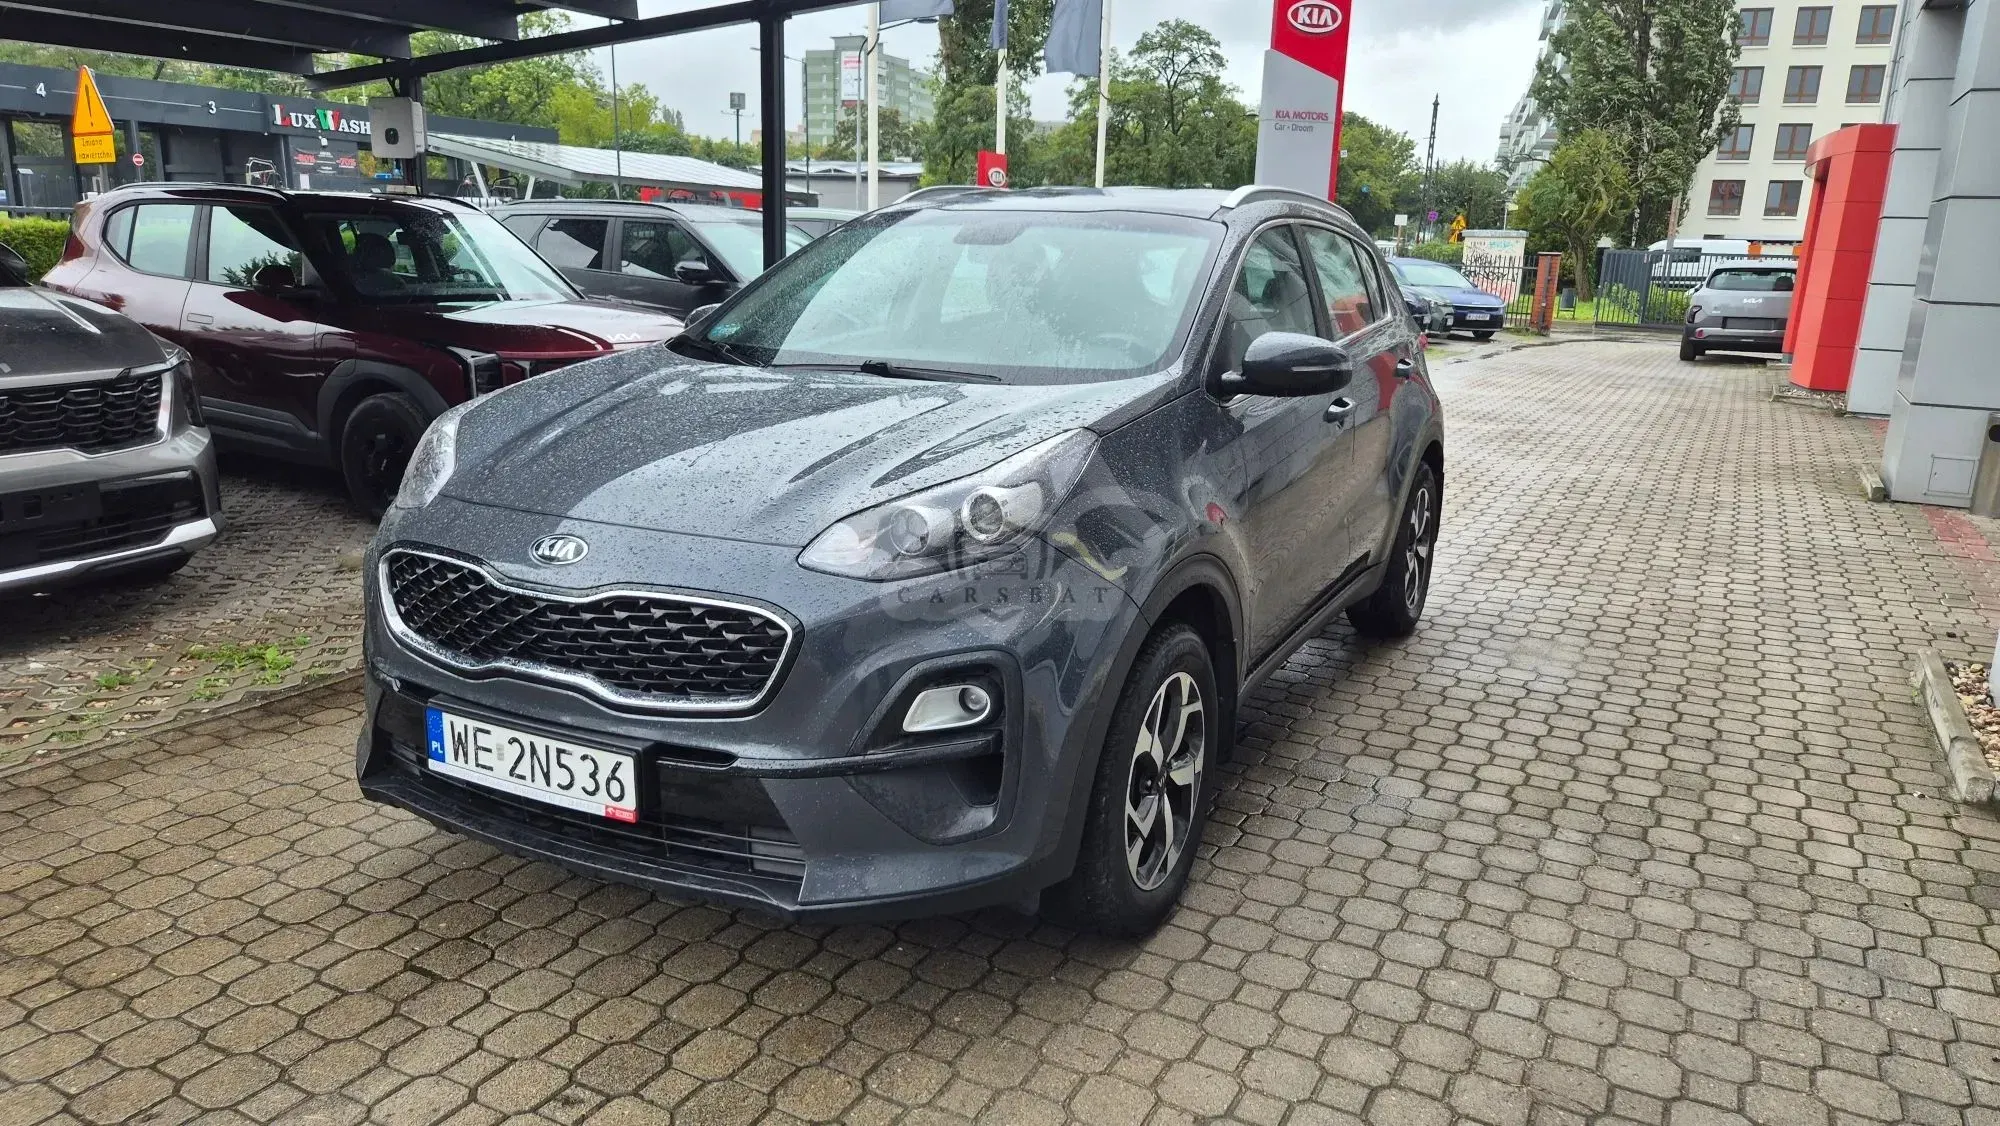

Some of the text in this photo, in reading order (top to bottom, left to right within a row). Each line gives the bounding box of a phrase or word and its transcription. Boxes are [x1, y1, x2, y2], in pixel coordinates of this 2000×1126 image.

[1297, 6, 1333, 26] KIA
[36, 82, 47, 98] 4
[208, 100, 217, 114] 3
[1275, 110, 1329, 121] KIA MOTORS
[537, 539, 576, 559] KIA
[431, 740, 443, 754] PL
[450, 720, 625, 802] WE 2N536
